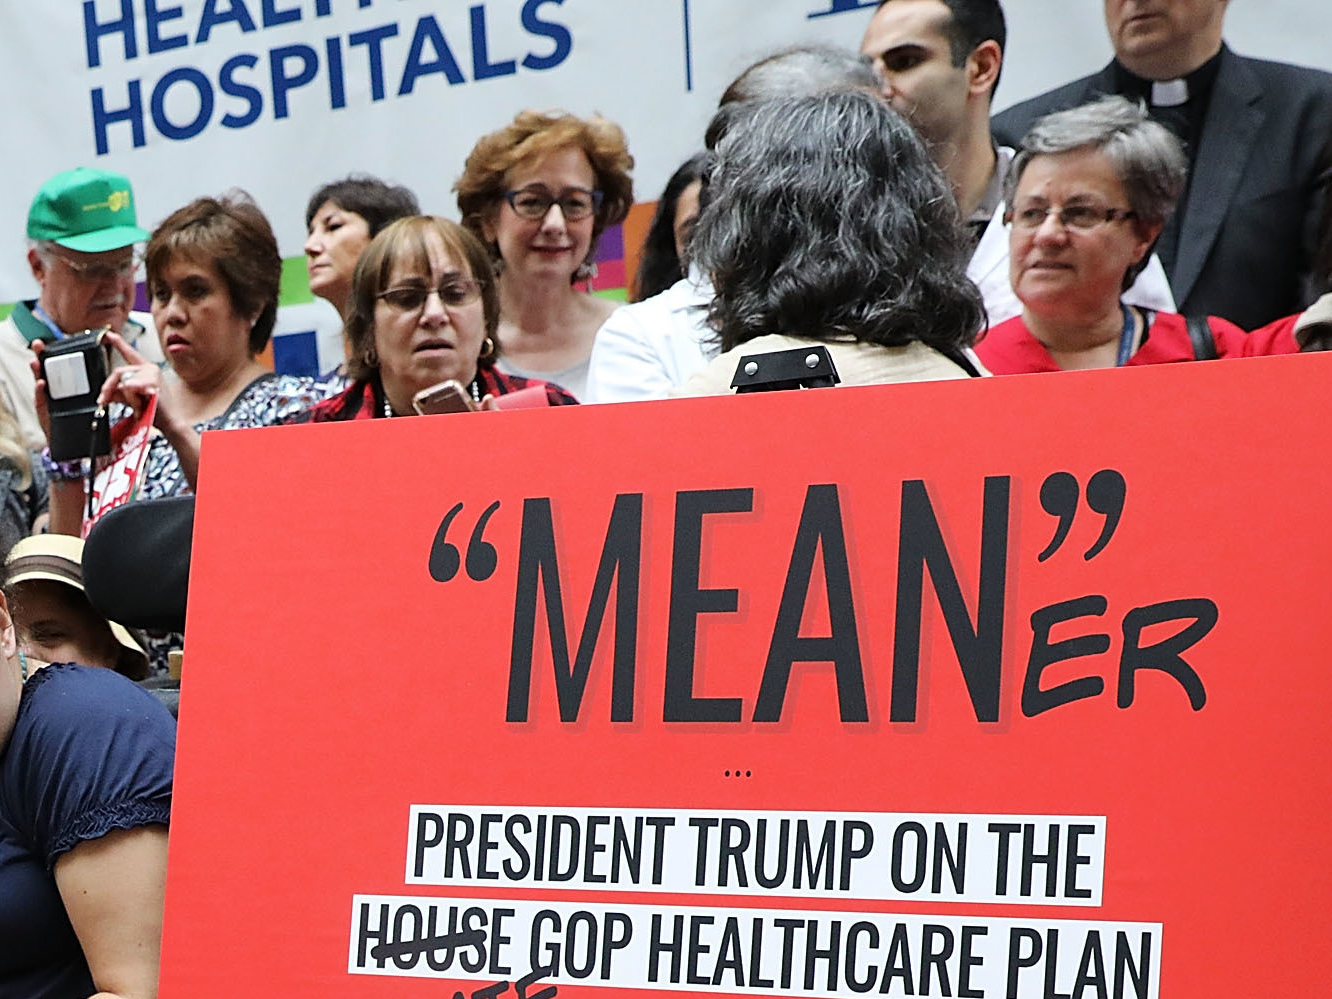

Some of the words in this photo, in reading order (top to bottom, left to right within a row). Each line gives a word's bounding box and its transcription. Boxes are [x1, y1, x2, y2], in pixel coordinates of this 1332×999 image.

[83, 0, 372, 68] HEA
[91, 0, 573, 155] HOSPITALS
[1021, 595, 1219, 718] ER
[413, 813, 676, 885] PRESIDENT
[688, 818, 874, 891] TRUMP
[890, 822, 968, 895] ON
[987, 823, 1096, 899] THE
[356, 903, 516, 975] HOUSE
[529, 909, 633, 981] GOP
[647, 914, 985, 999] HEALTHCARE
